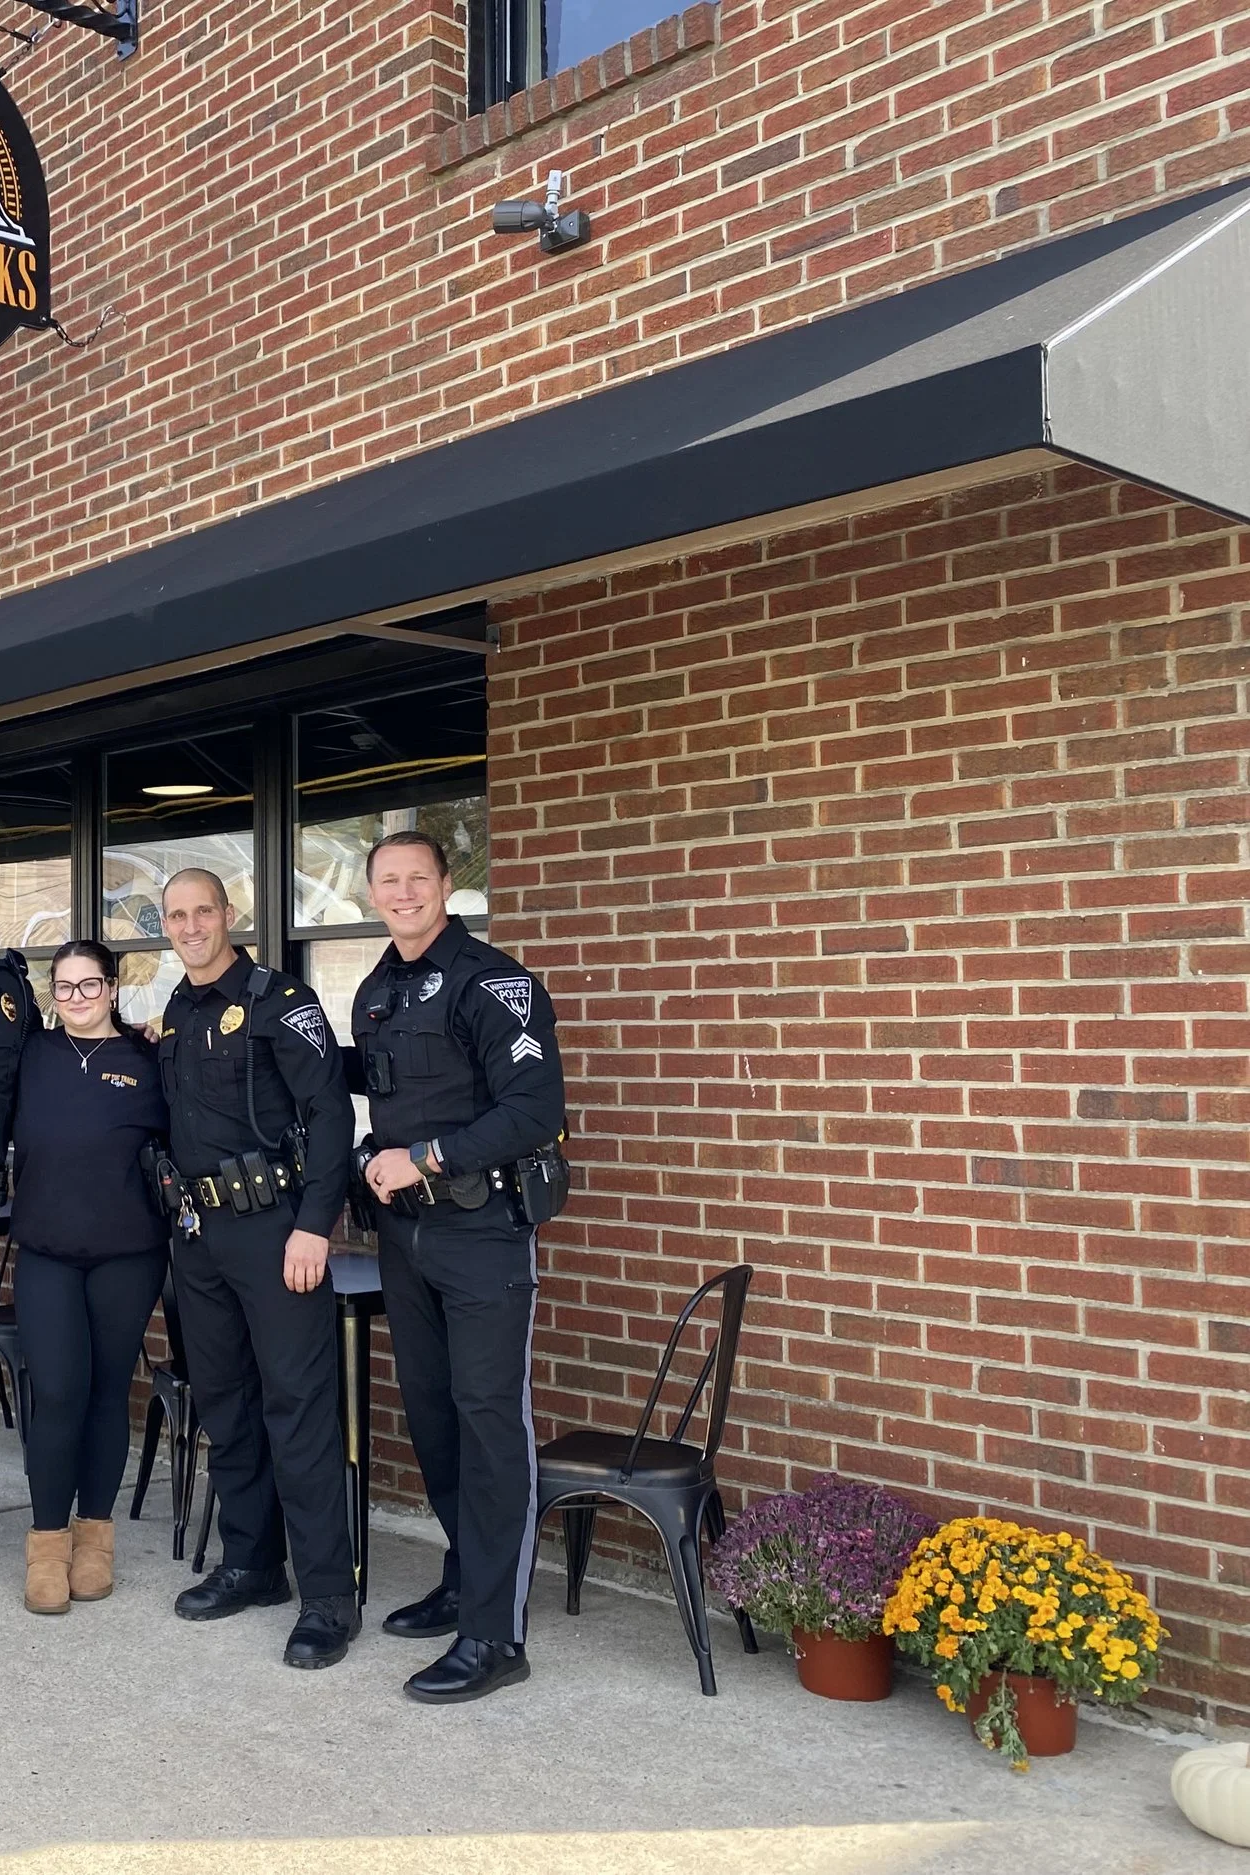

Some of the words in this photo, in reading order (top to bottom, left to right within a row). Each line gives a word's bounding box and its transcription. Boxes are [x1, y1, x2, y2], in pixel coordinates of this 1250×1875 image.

[499, 988, 529, 1001] POLICE
[510, 998, 527, 1015] NJ
[297, 1016, 323, 1031] POLICE
